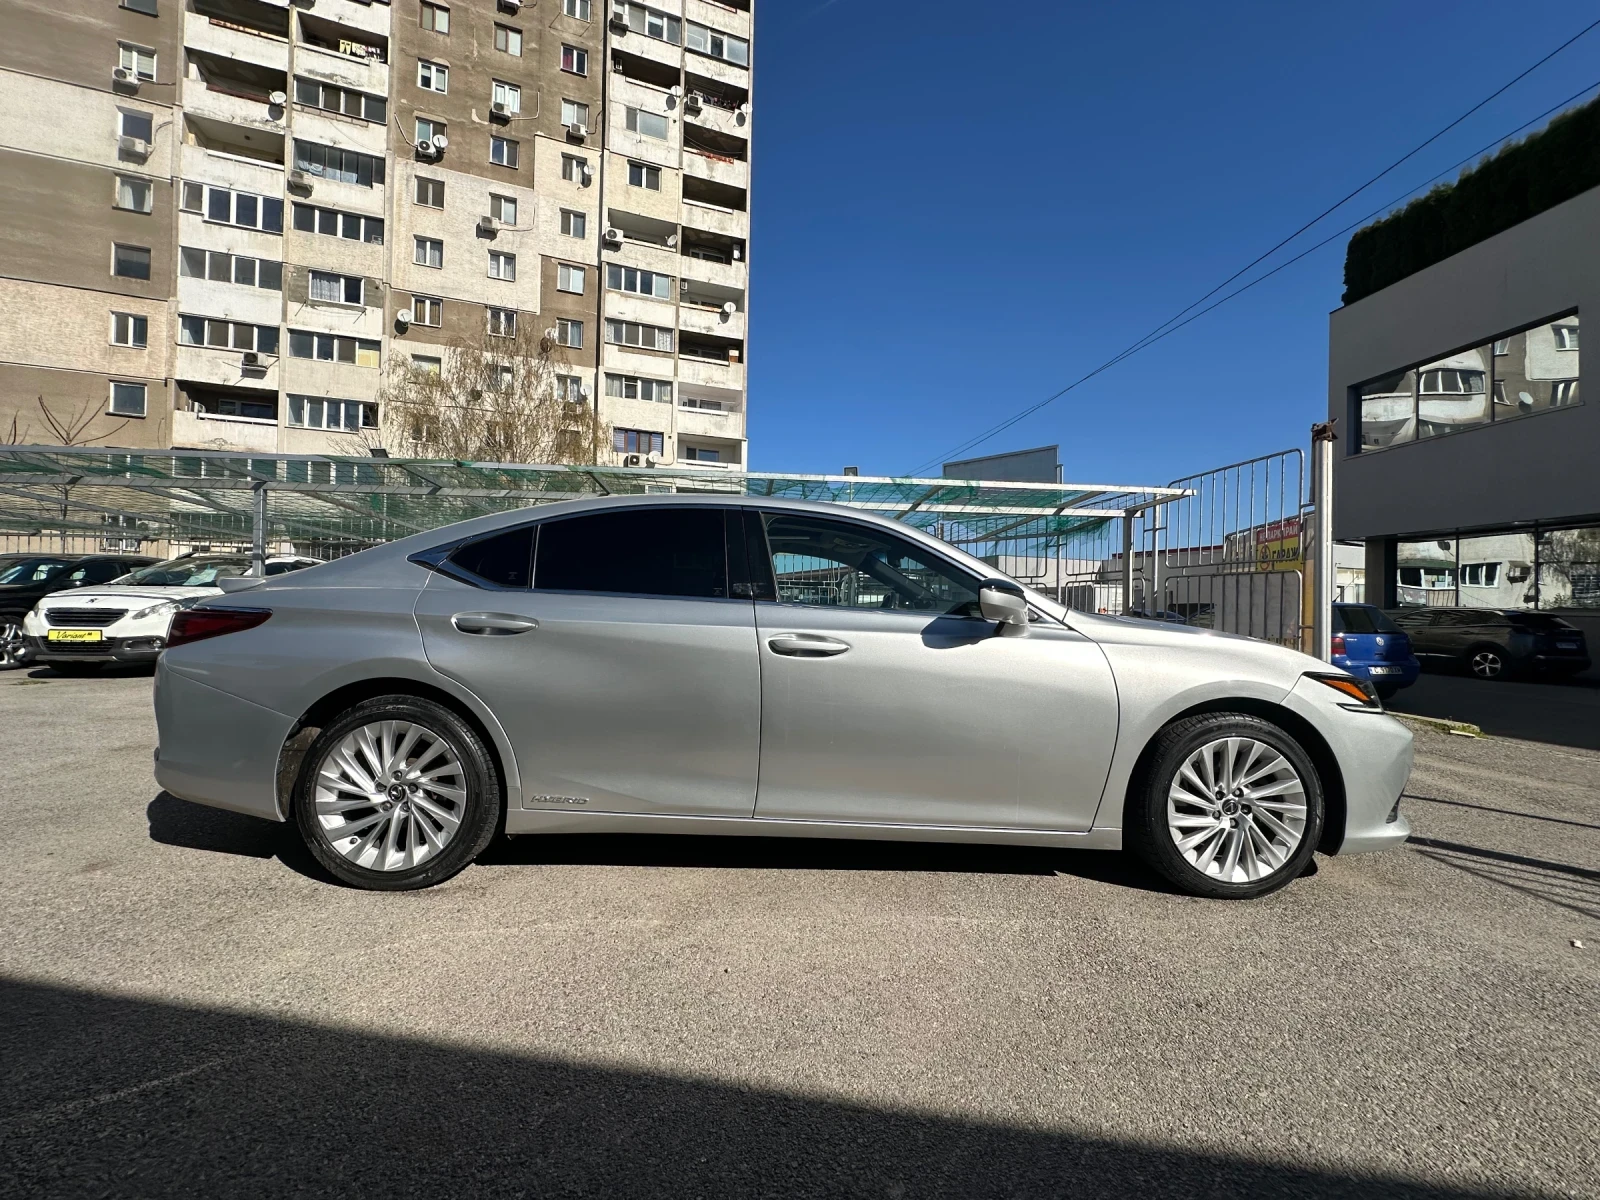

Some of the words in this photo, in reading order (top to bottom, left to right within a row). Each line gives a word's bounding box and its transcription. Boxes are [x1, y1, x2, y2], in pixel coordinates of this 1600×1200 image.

[1272, 547, 1299, 564] ГАРАЖ
[56, 631, 86, 639] Variant
[530, 795, 590, 805] HYBRID
